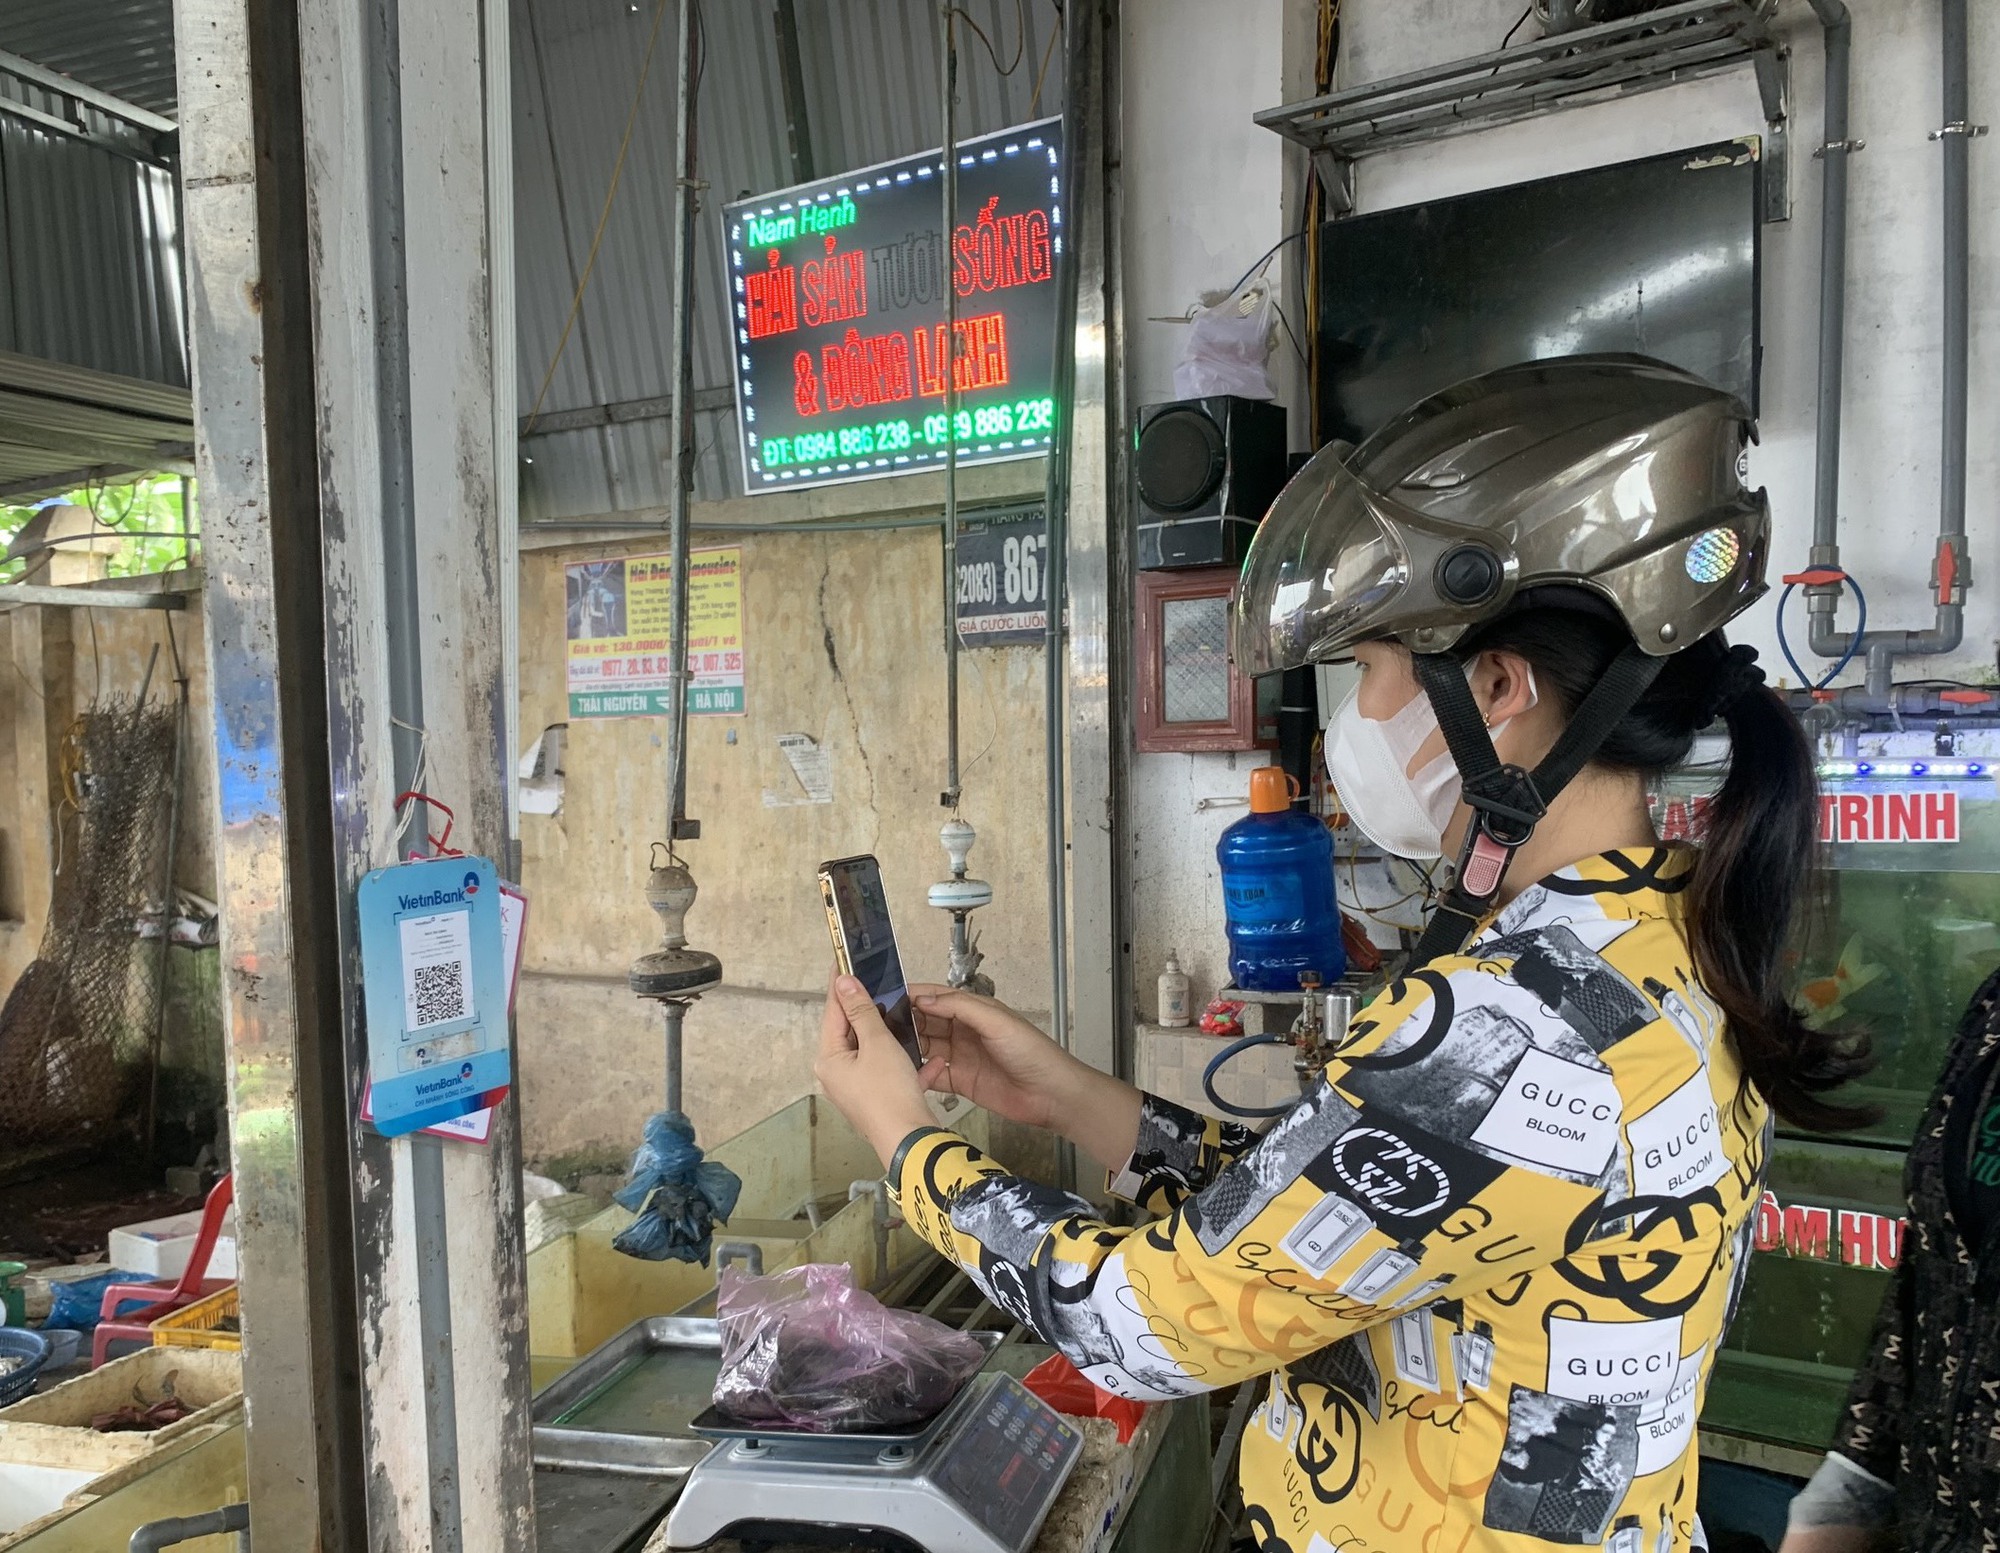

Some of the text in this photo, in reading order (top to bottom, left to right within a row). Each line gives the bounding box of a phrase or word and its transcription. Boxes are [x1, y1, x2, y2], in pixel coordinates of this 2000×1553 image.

[748, 195, 857, 248] Nam Hạnh
[744, 247, 799, 339] HẢI
[801, 235, 868, 328] SẢN
[952, 196, 1052, 298] SỐNG
[793, 350, 821, 417] &
[821, 327, 913, 412] ĐÔNG
[793, 431, 836, 463] 0984
[838, 426, 874, 457] 886
[875, 419, 911, 452] 238
[974, 404, 1014, 439] 886
[956, 561, 997, 606] 2083)
[958, 617, 978, 634] GIÁ
[577, 689, 735, 713] THÁI NGUYÊN HÀ NỘI
[1525, 1117, 1587, 1143] BLOOM
[1668, 1150, 1714, 1191] BLOOM
[1755, 1192, 1829, 1259] ÔM
[1567, 1350, 1672, 1376] GUCCI
[1587, 1389, 1650, 1406] BLOOM
[1649, 1412, 1687, 1439] BLOOM
[1282, 1458, 1311, 1534] GUCCI
